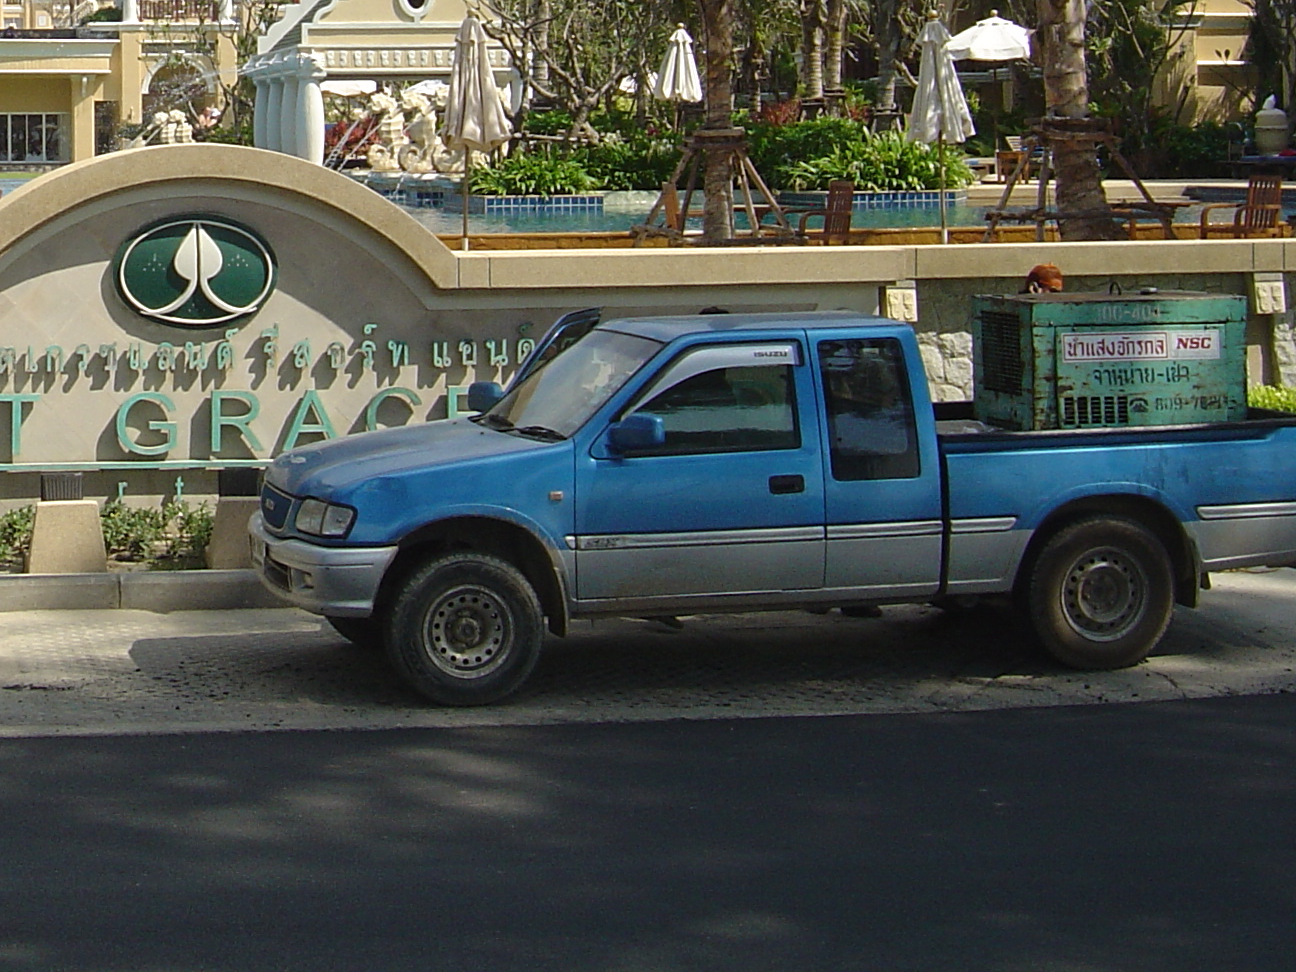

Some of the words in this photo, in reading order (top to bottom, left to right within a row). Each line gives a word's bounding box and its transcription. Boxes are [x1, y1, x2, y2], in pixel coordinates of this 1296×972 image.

[261, 323, 409, 368] รีสอร์ท
[1176, 336, 1212, 350] NSC
[754, 350, 788, 358] ISUZU
